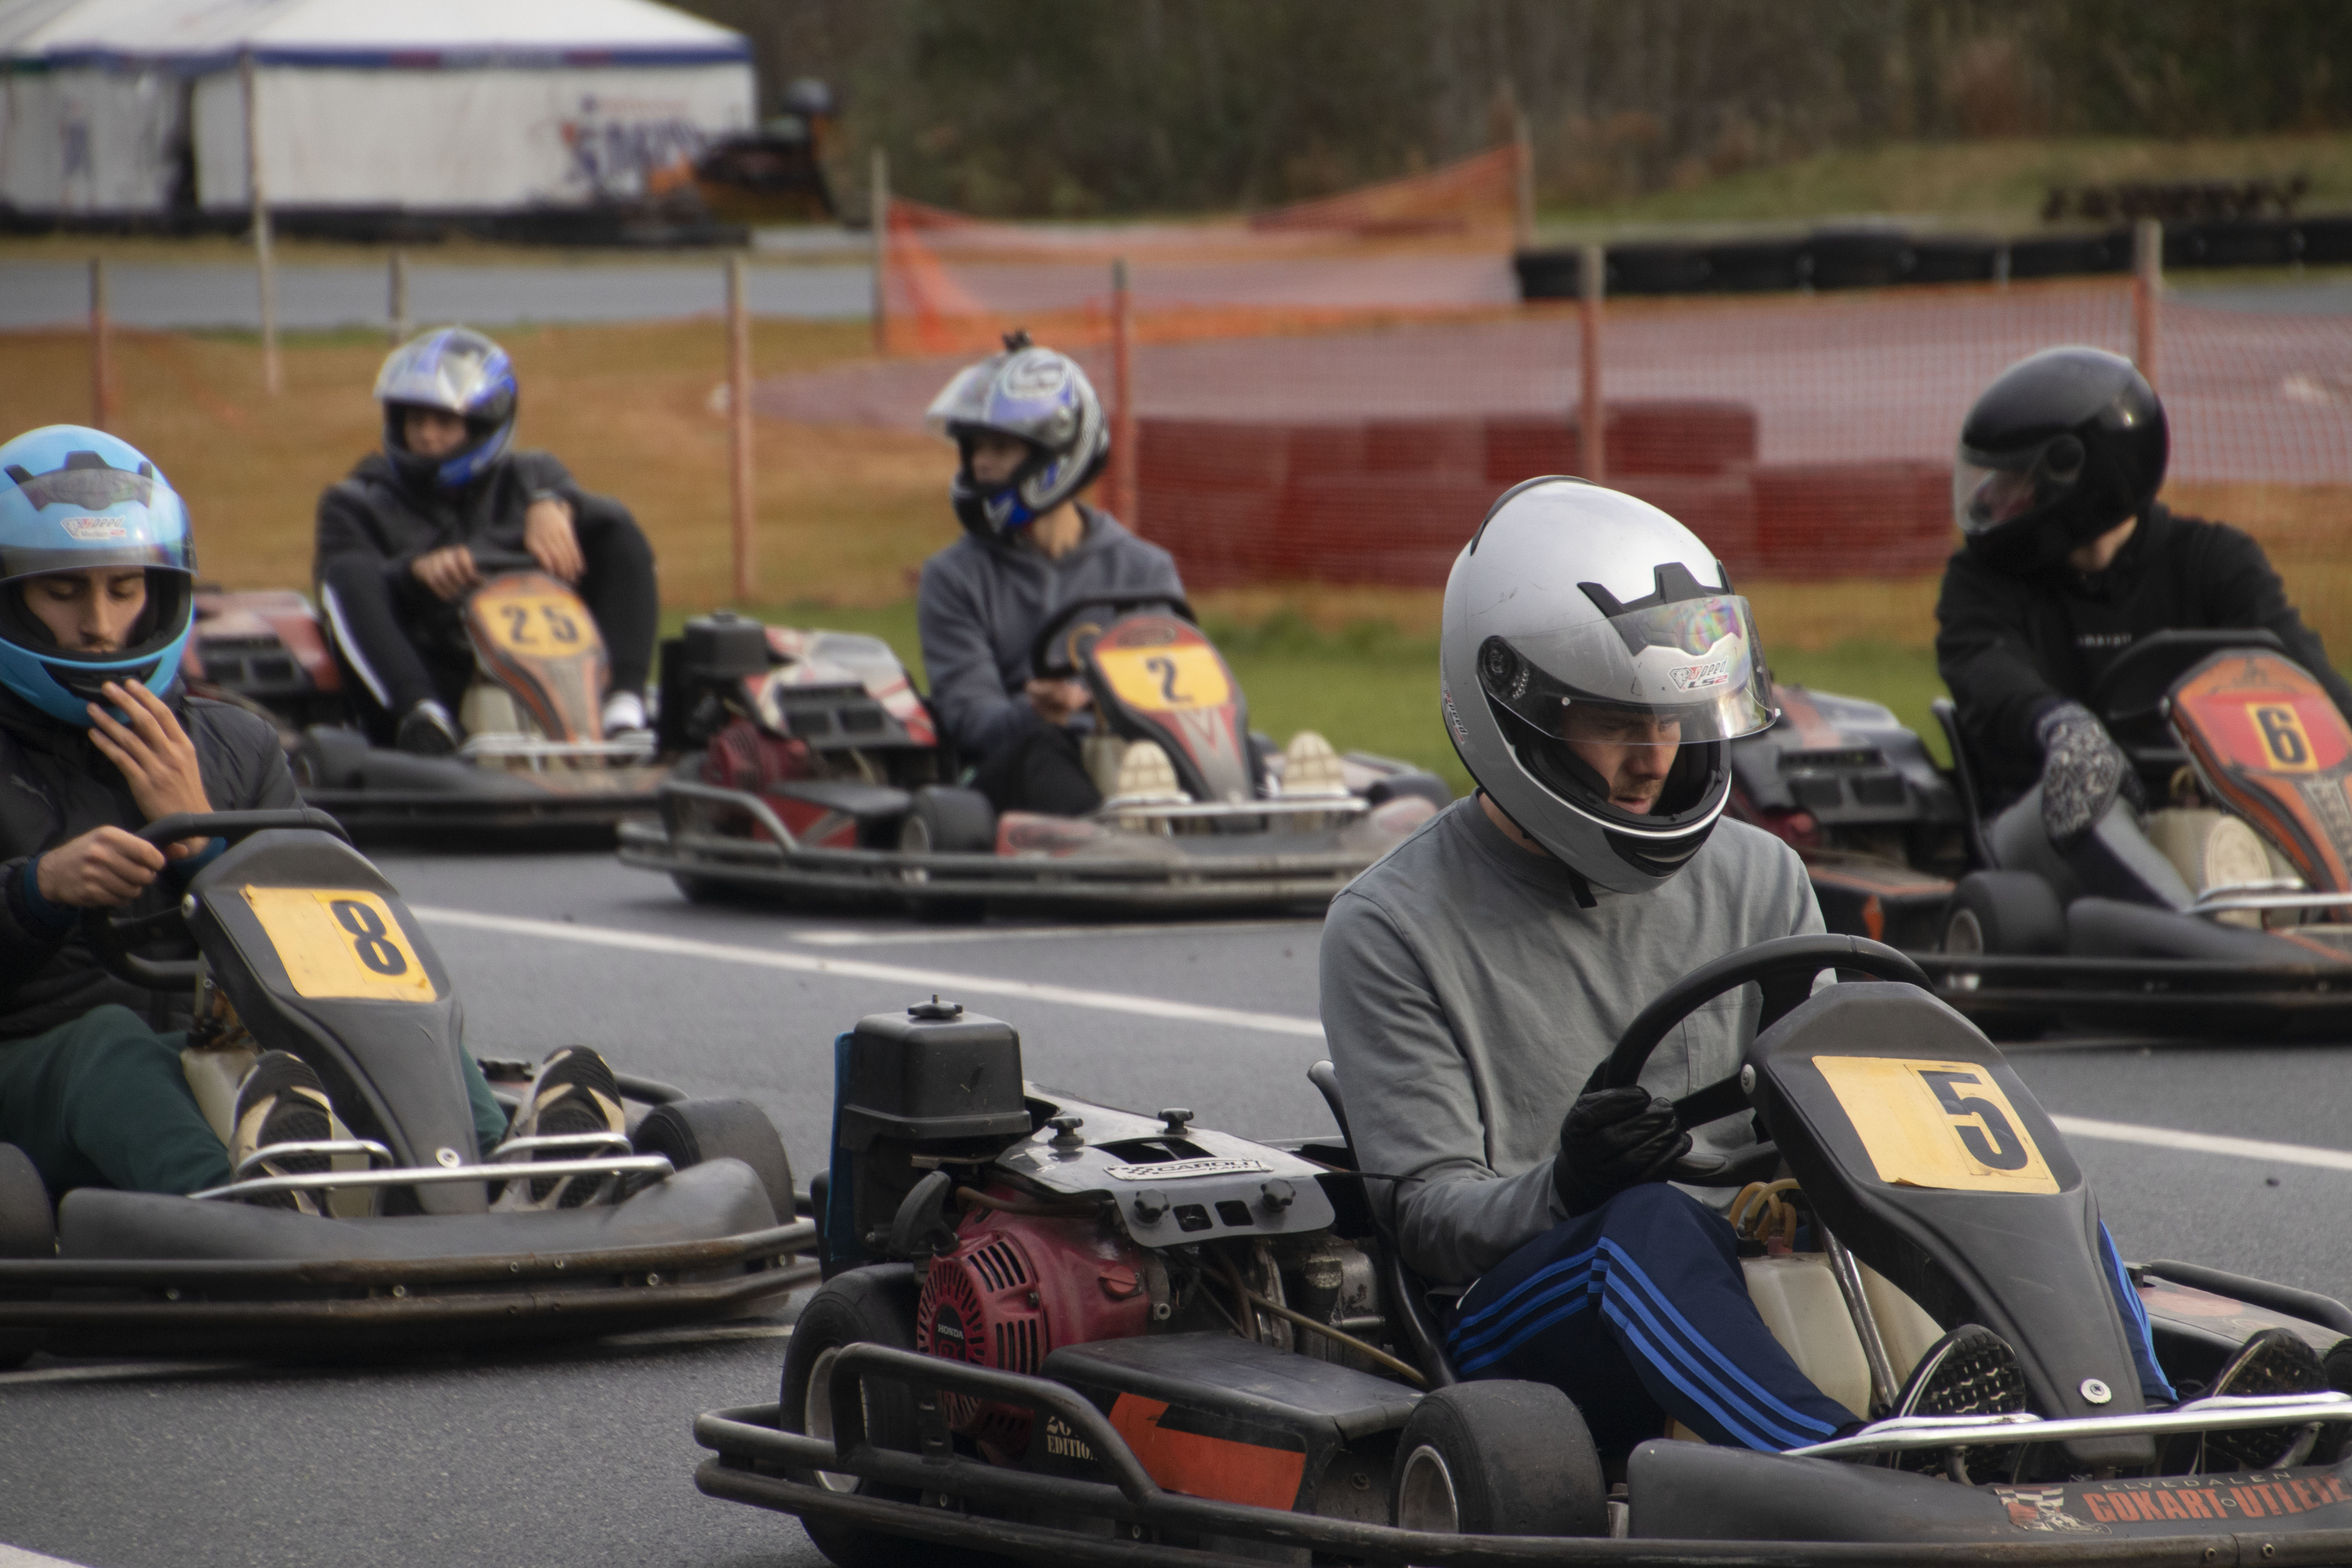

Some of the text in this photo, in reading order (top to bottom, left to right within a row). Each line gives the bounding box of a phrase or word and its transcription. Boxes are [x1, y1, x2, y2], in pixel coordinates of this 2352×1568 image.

[500, 605, 579, 643] 25
[1147, 657, 1195, 702] 2
[1688, 674, 1728, 688] LS2
[2256, 707, 2309, 765] 6
[329, 900, 407, 975] 8
[1917, 1070, 2028, 1171] 5
[938, 1323, 964, 1340] HONDA
[1047, 1434, 1098, 1461] EDITIO
[2102, 1472, 2291, 1490] ELVEDALEN
